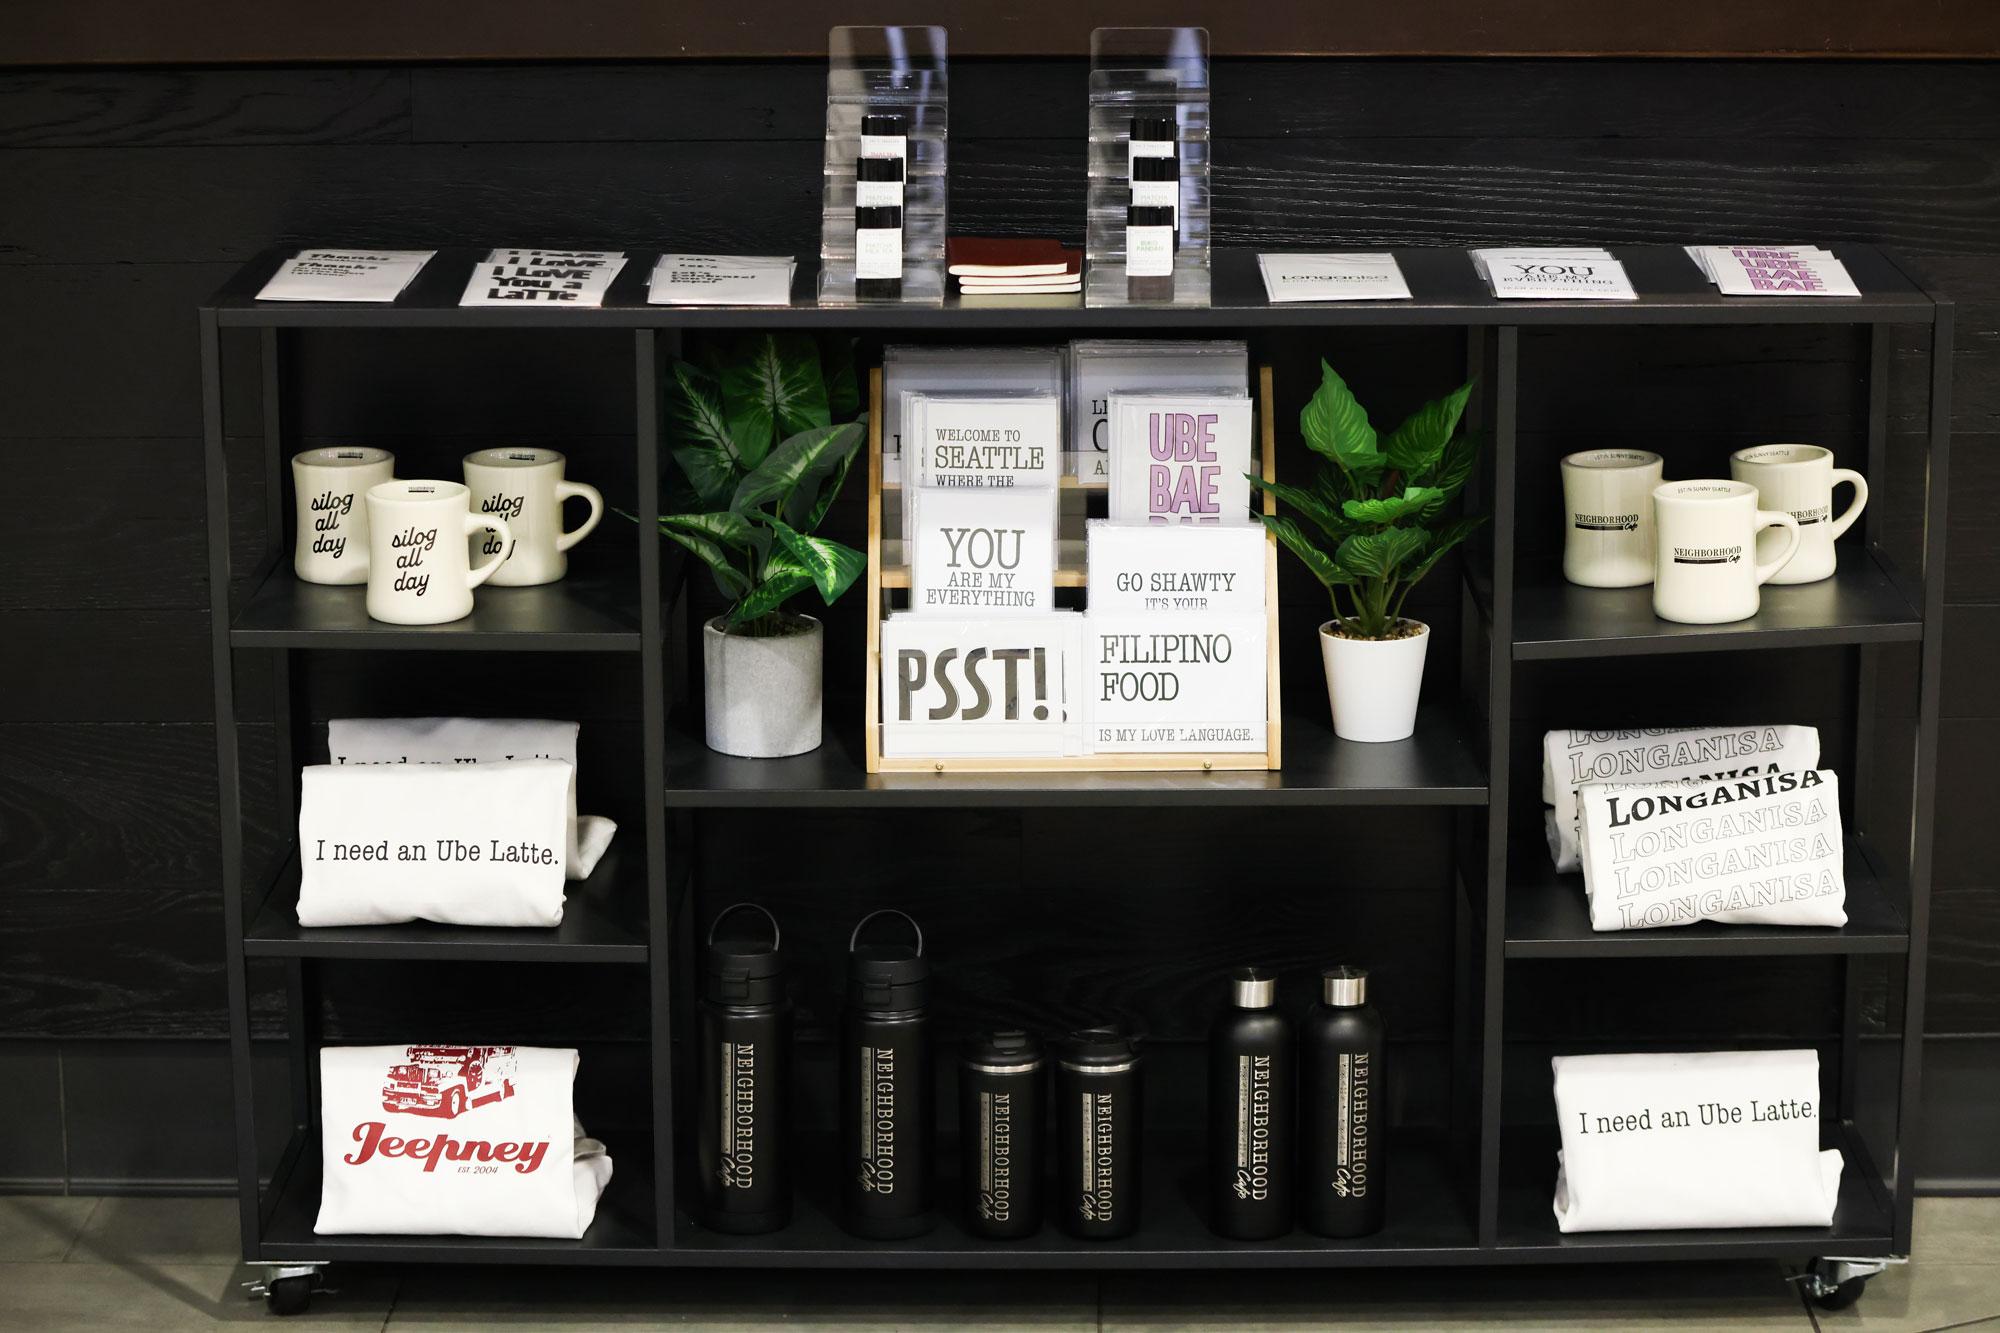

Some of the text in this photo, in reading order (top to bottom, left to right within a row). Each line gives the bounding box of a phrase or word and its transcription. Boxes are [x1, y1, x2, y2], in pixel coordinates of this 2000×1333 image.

[1510, 264, 1596, 276] YOU
[1739, 258, 1813, 270] UBE
[1745, 268, 1822, 281] BAE
[562, 281, 583, 290] a
[1750, 279, 1828, 292] BAE
[935, 428, 1021, 442] WELCOME TO
[1149, 413, 1218, 462] UBE
[934, 445, 1044, 470] SEATTLE
[935, 474, 1014, 487] WHERE THE
[1149, 464, 1221, 514] BAE
[311, 491, 354, 515] silog
[482, 493, 525, 517] silog
[315, 511, 340, 531] all
[1575, 514, 1639, 524] NEIGHBORHOOD
[313, 534, 347, 559] day
[392, 526, 438, 551] silog
[940, 527, 1026, 570] YOU
[396, 546, 423, 569] all
[1674, 546, 1742, 557] NEIGHBORHOOD
[394, 571, 430, 597] day
[947, 571, 1016, 589] ARE MY
[1116, 572, 1236, 592] GO SHAWTY
[926, 588, 1036, 607] EVERYTHING
[1144, 597, 1208, 611] IT'S YOUR
[1100, 633, 1232, 664] FILIPINO
[898, 647, 1049, 721] PSST!
[1100, 671, 1179, 702] FOOD
[1098, 728, 1254, 742] IS MY LOVE LANGUAGE.
[1569, 728, 1784, 784] LONGANISA
[1606, 769, 1824, 828] LONGANISA
[1609, 798, 1828, 864] LONGANISA
[316, 839, 559, 866] I need an Ube Latte.
[1614, 832, 1834, 899] LONGANISA
[1618, 868, 1840, 929] LONGANISA
[736, 1043, 754, 1190] NEIGHBORHOOD
[876, 1048, 894, 1194] NEIGHBORHOOD
[1252, 1055, 1270, 1201] NEIGHBORHOOD
[1351, 1052, 1369, 1198] NEIGHBORHOOD
[1578, 1099, 1817, 1134] I need an Ube Latte.
[343, 1121, 550, 1174] Jeepney
[994, 1093, 1010, 1222] NEIGHBORHOOD
[1097, 1093, 1113, 1222] NEIGHBORHOOD
[473, 1165, 499, 1175] 2004
